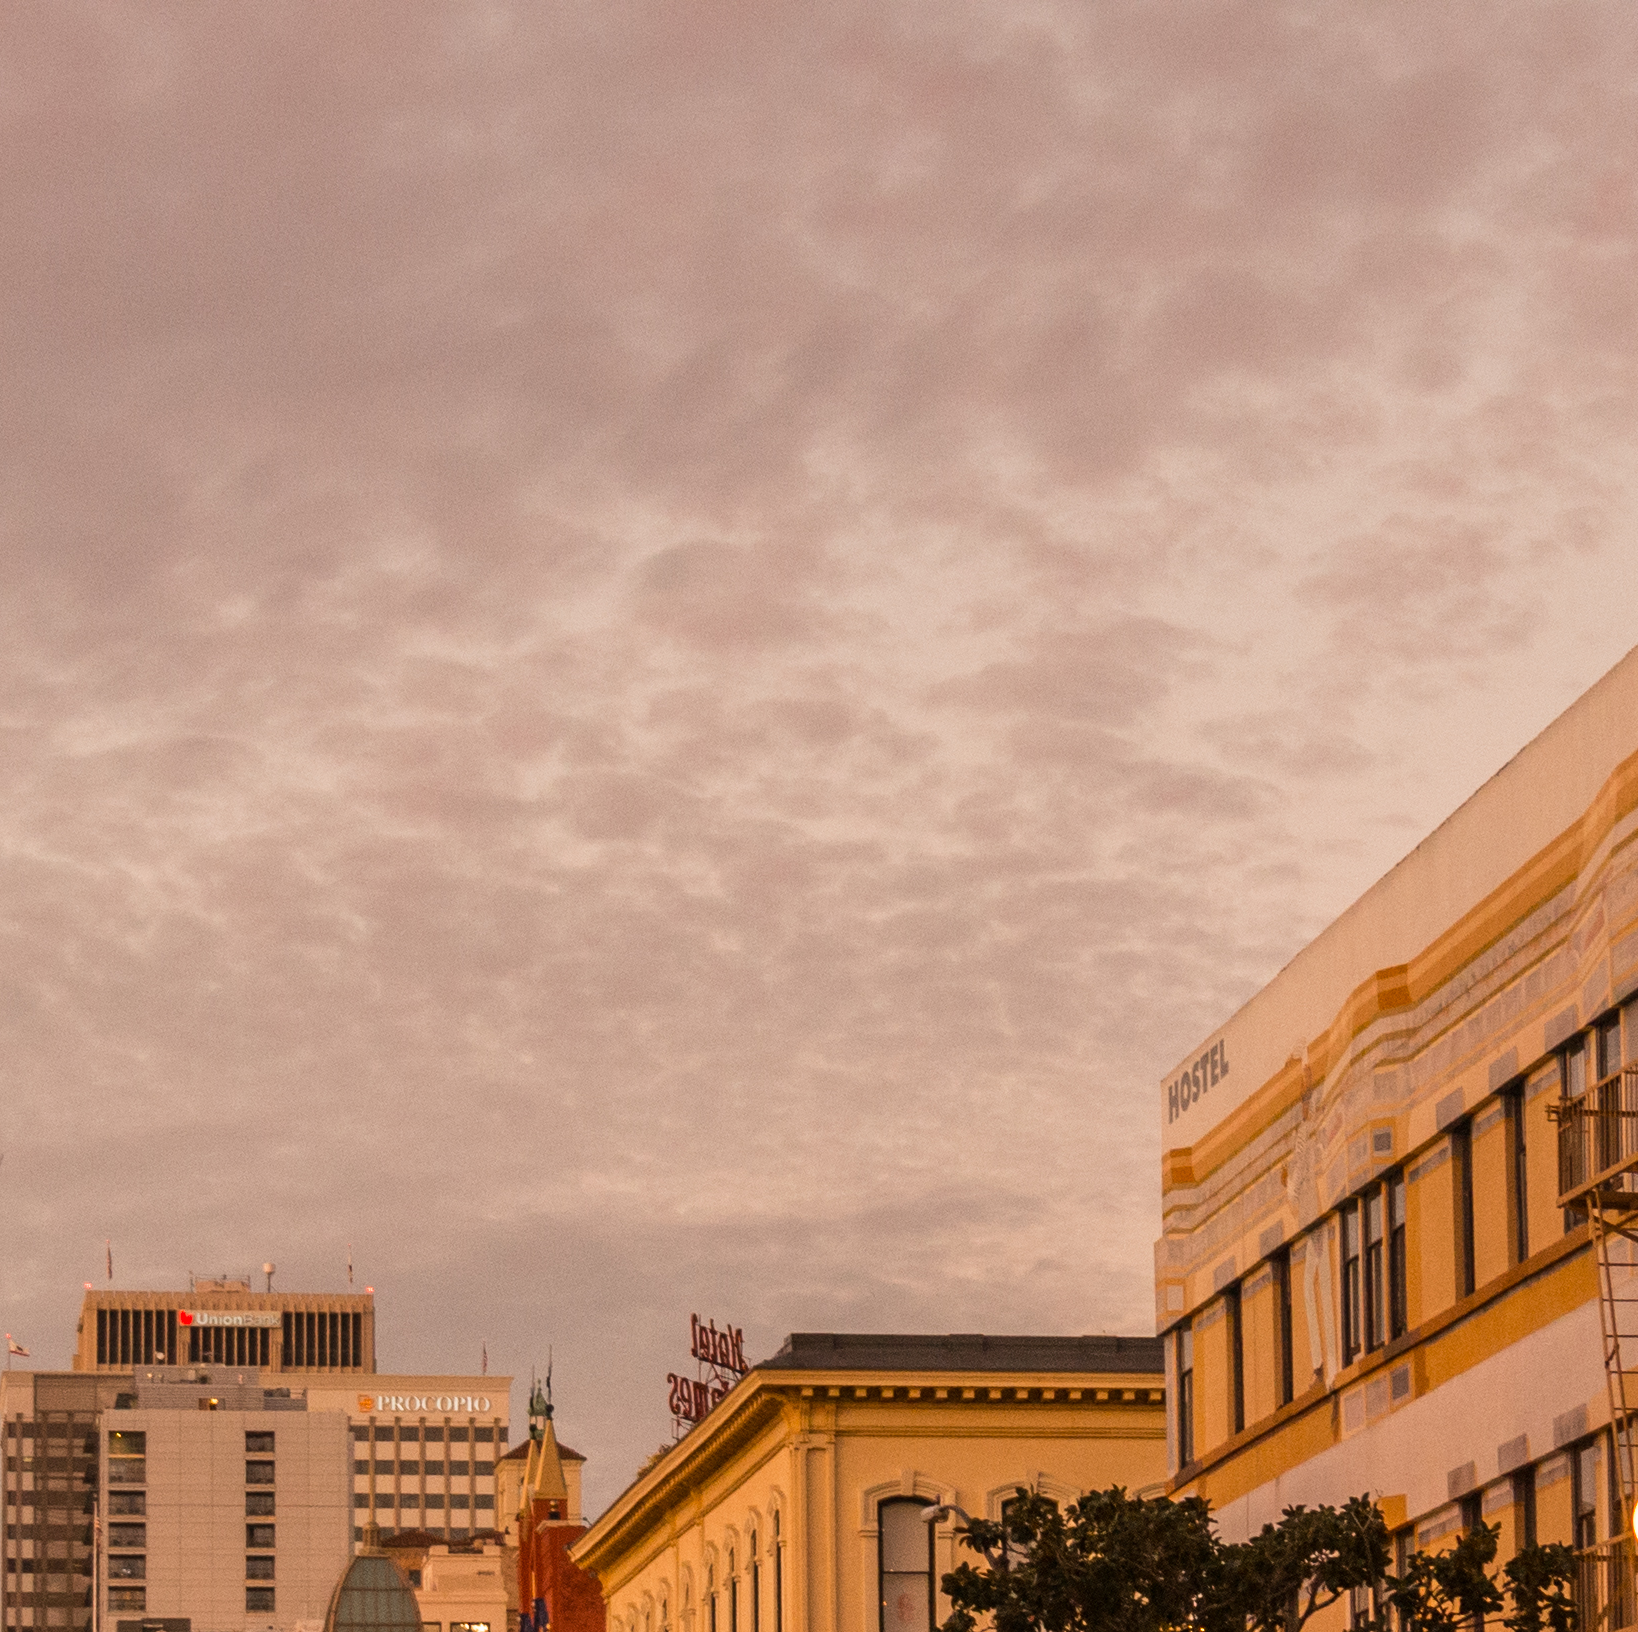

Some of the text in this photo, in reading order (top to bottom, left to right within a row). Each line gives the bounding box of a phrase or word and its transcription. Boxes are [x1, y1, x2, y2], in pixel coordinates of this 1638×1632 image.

[1167, 1038, 1229, 1124] HOSTEL
[196, 1312, 280, 1326] UnionBank
[376, 1395, 490, 1412] PROCOPIO
